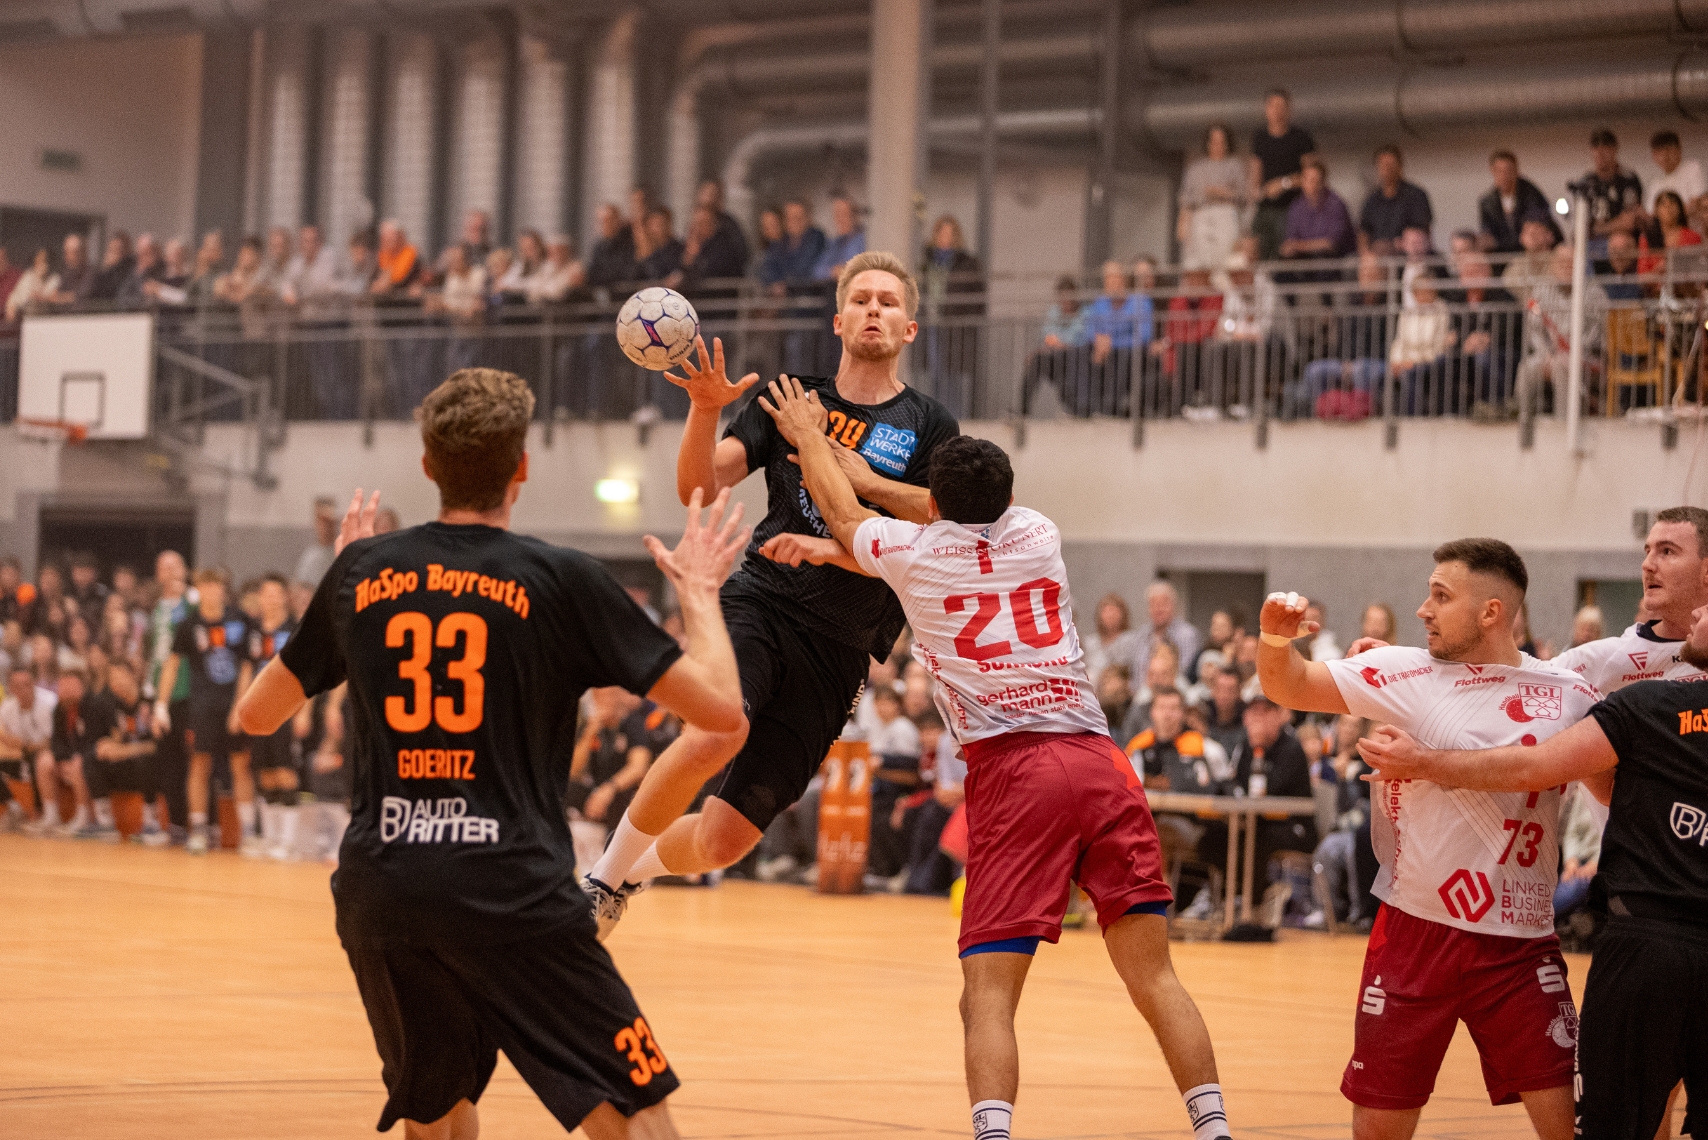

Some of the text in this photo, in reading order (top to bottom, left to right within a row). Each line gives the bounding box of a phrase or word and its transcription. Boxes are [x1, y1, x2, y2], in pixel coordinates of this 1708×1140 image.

[863, 448, 907, 473] Bayreuth
[355, 563, 530, 620] HaSpo Bayreuth
[943, 577, 1065, 661] 20
[384, 611, 488, 734] 33
[1454, 675, 1506, 687] Flottweg
[1622, 670, 1664, 681] Flottweg
[976, 680, 1048, 706] gerhard
[1001, 694, 1053, 712] mann
[1521, 685, 1559, 699] TGL
[398, 749, 476, 780] GOERITZ
[411, 797, 468, 819] AUTO
[407, 816, 500, 843] RITTER
[1497, 819, 1545, 868] 73
[1502, 879, 1551, 897] LINKED
[1502, 895, 1552, 913] BUSINE
[614, 1016, 667, 1086] 33
